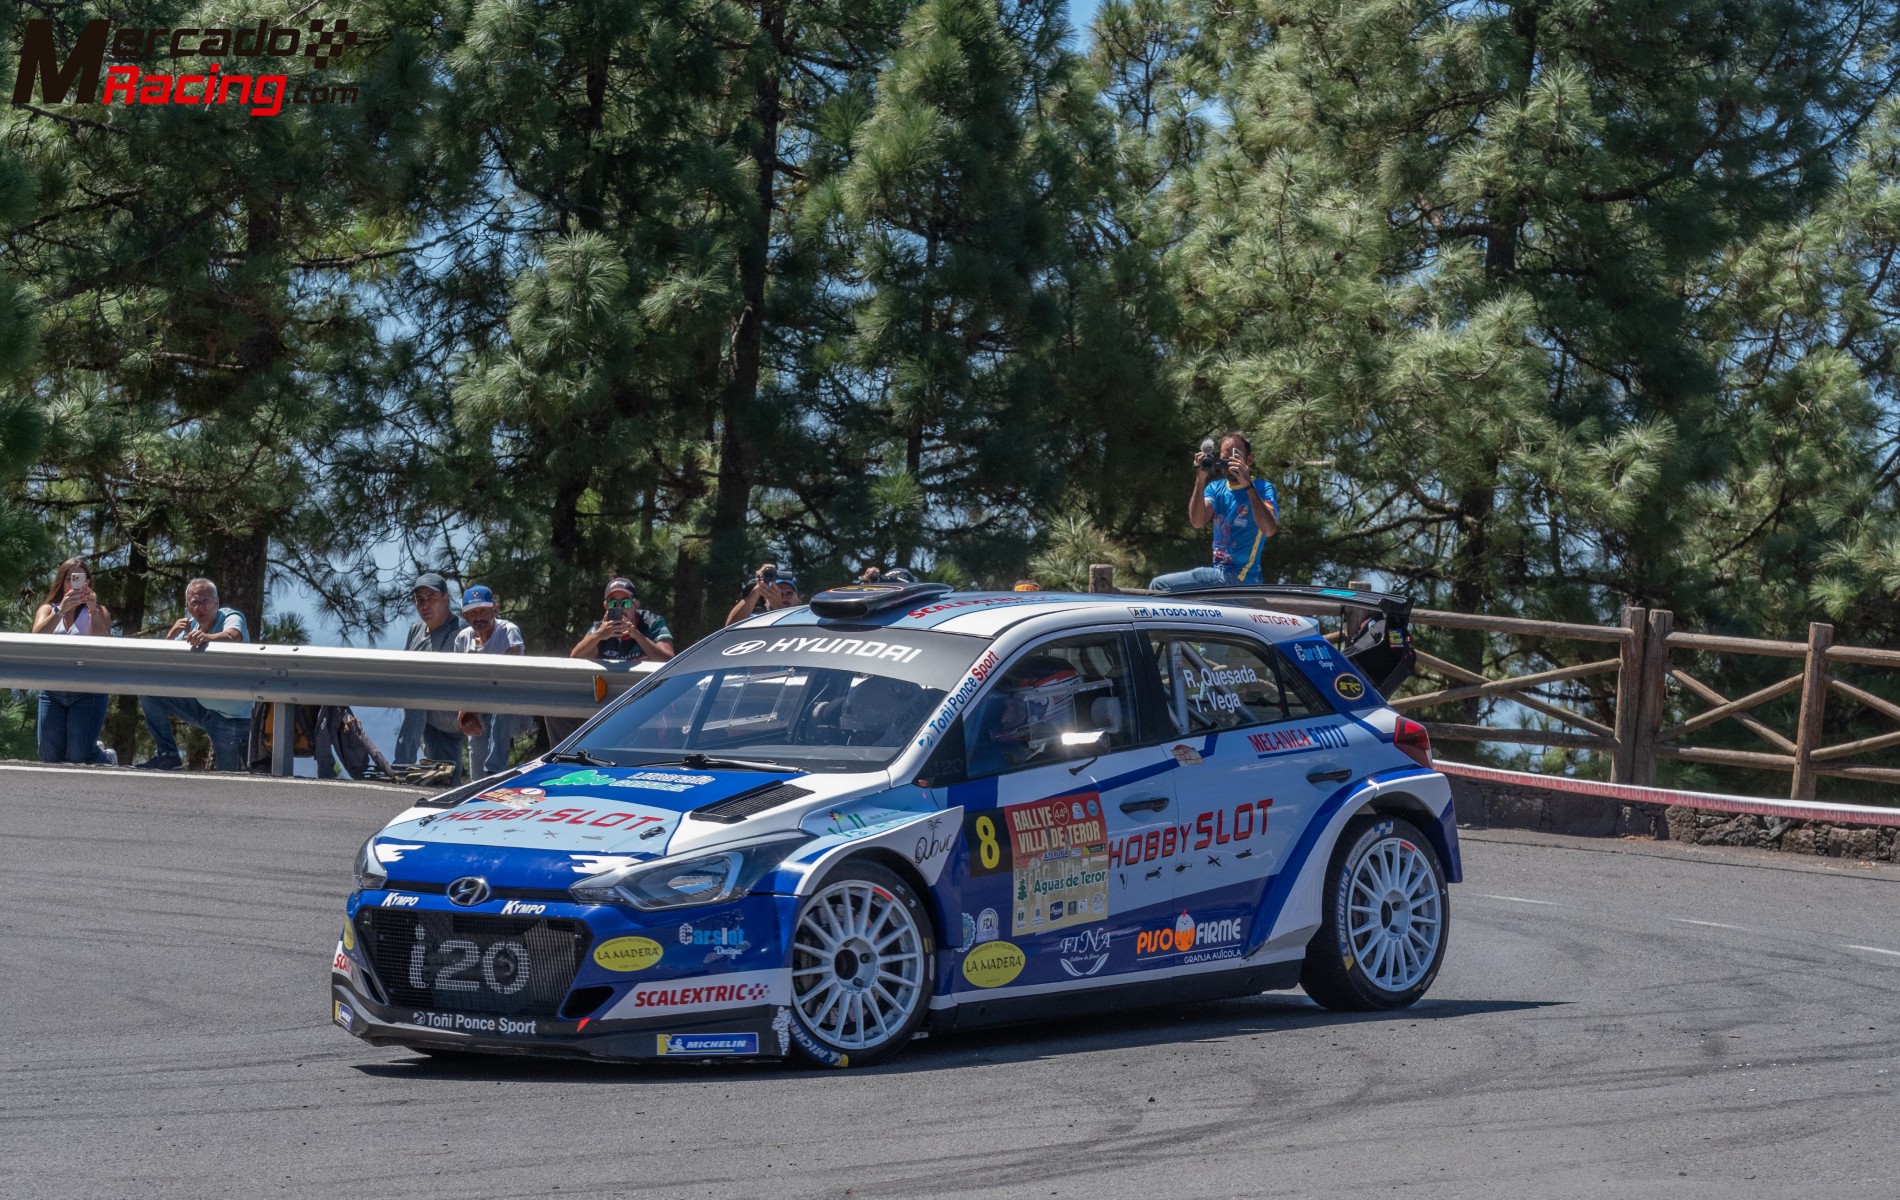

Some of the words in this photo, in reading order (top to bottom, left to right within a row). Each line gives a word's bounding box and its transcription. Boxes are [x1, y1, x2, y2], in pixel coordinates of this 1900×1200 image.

[1152, 608, 1160, 616] A
[1161, 608, 1188, 617] TODO
[1189, 609, 1223, 618] MOTOR
[1249, 614, 1289, 625] VICTOR
[766, 637, 923, 664] HYUNDAI
[1183, 669, 1200, 688] R.
[1201, 665, 1257, 687] Quesada
[1339, 682, 1360, 694] SRC
[929, 705, 955, 735] Toñi
[948, 677, 977, 712] Ponce
[972, 650, 999, 682] Sport
[1192, 694, 1207, 713] T.
[1207, 691, 1241, 714] Vega
[1247, 728, 1312, 753] MECANICA
[1012, 806, 1054, 831] RALLYE
[976, 815, 1001, 869] 8
[1017, 829, 1049, 854] VILLA
[1050, 827, 1066, 849] DE
[1066, 821, 1101, 846] TEROR
[1033, 879, 1064, 895] Aguas
[1065, 874, 1079, 887] de
[1080, 871, 1106, 884] Teror
[381, 892, 419, 907] KYMPO
[501, 900, 546, 915] KYMPO
[1340, 872, 1351, 944] MICHELIN
[1060, 928, 1111, 954] FINA
[1136, 928, 1173, 955] PISO
[1195, 917, 1242, 946] FIRME
[409, 924, 531, 995] i20
[597, 951, 611, 961] LA
[613, 947, 660, 960] MADERA
[966, 960, 979, 973] LA
[981, 956, 1022, 971] MADERA
[1184, 954, 1211, 964] GRANJA
[634, 983, 748, 1008] SCALEXTRIC
[427, 1012, 450, 1027] Toñi
[456, 1014, 496, 1031] Ponce
[499, 1018, 537, 1034] Sport
[686, 1039, 746, 1049] MICHELIN
[789, 1018, 829, 1058] MICHEL
